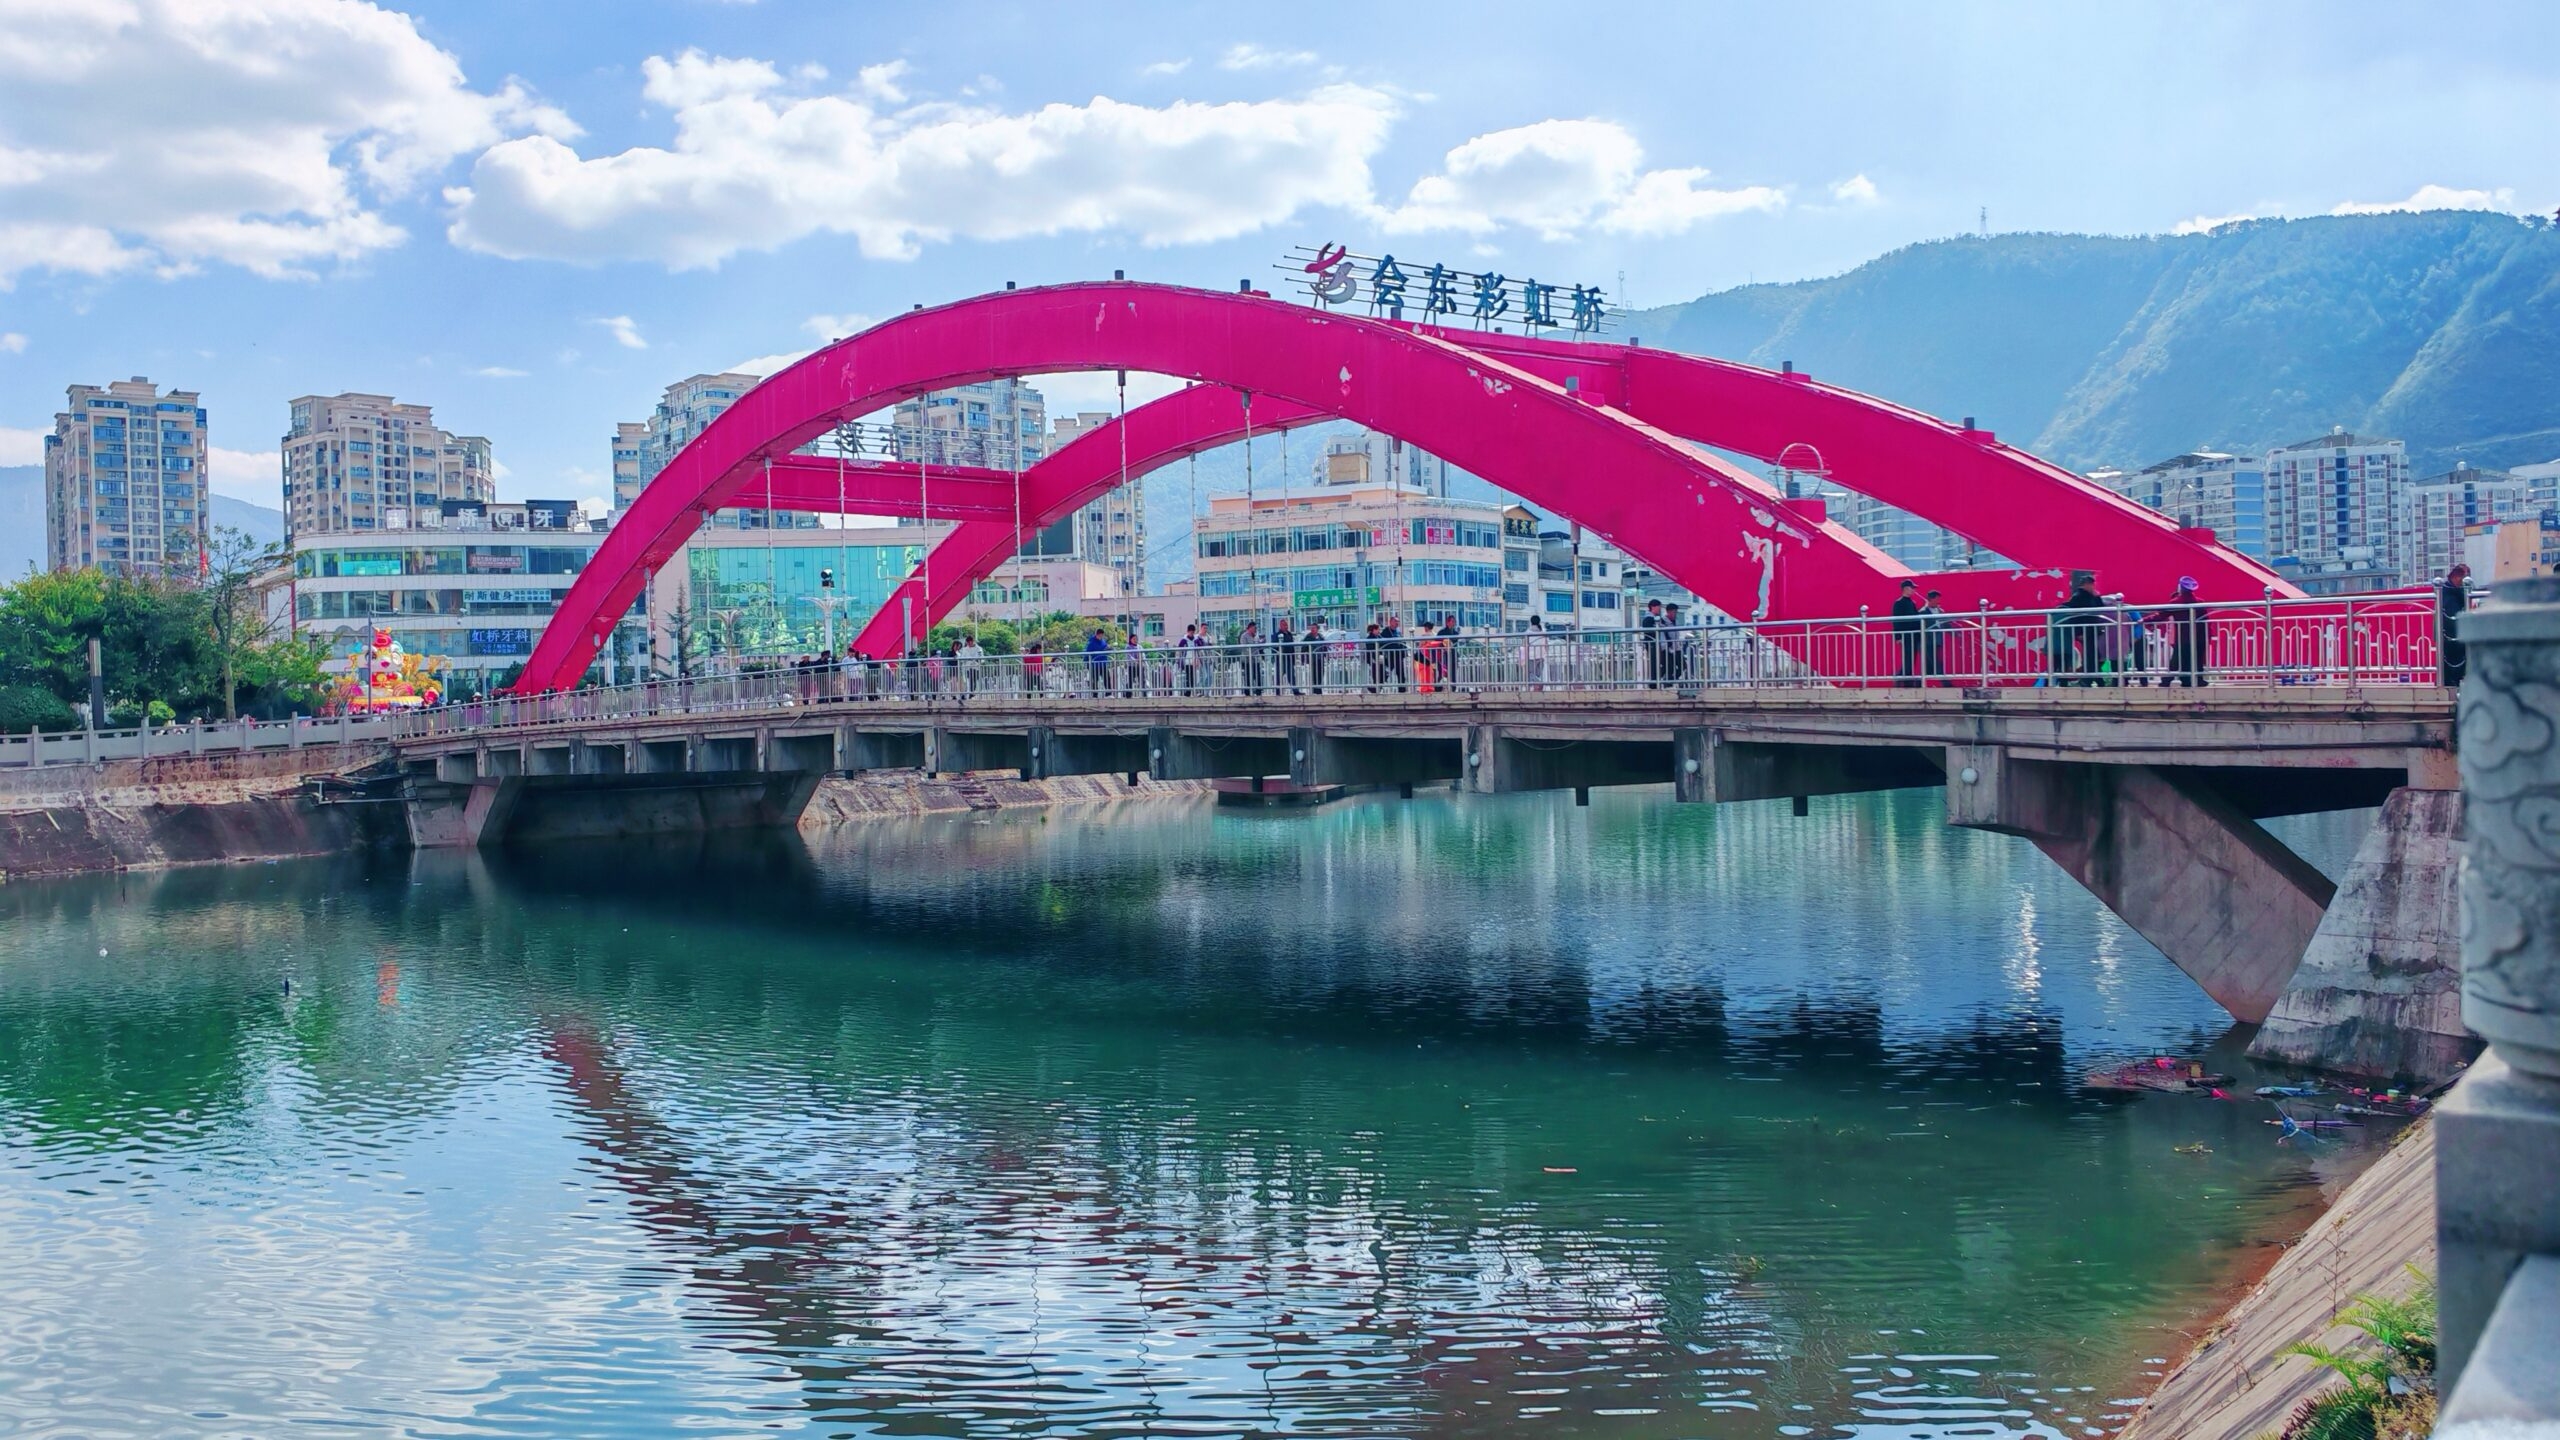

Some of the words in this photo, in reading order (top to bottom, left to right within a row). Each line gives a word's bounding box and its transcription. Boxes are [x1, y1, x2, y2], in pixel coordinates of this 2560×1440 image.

[1370, 254, 1606, 333] 会东彩虹桥
[464, 590, 513, 601] 耐斯健身
[471, 629, 529, 642] 虹桥牙科
